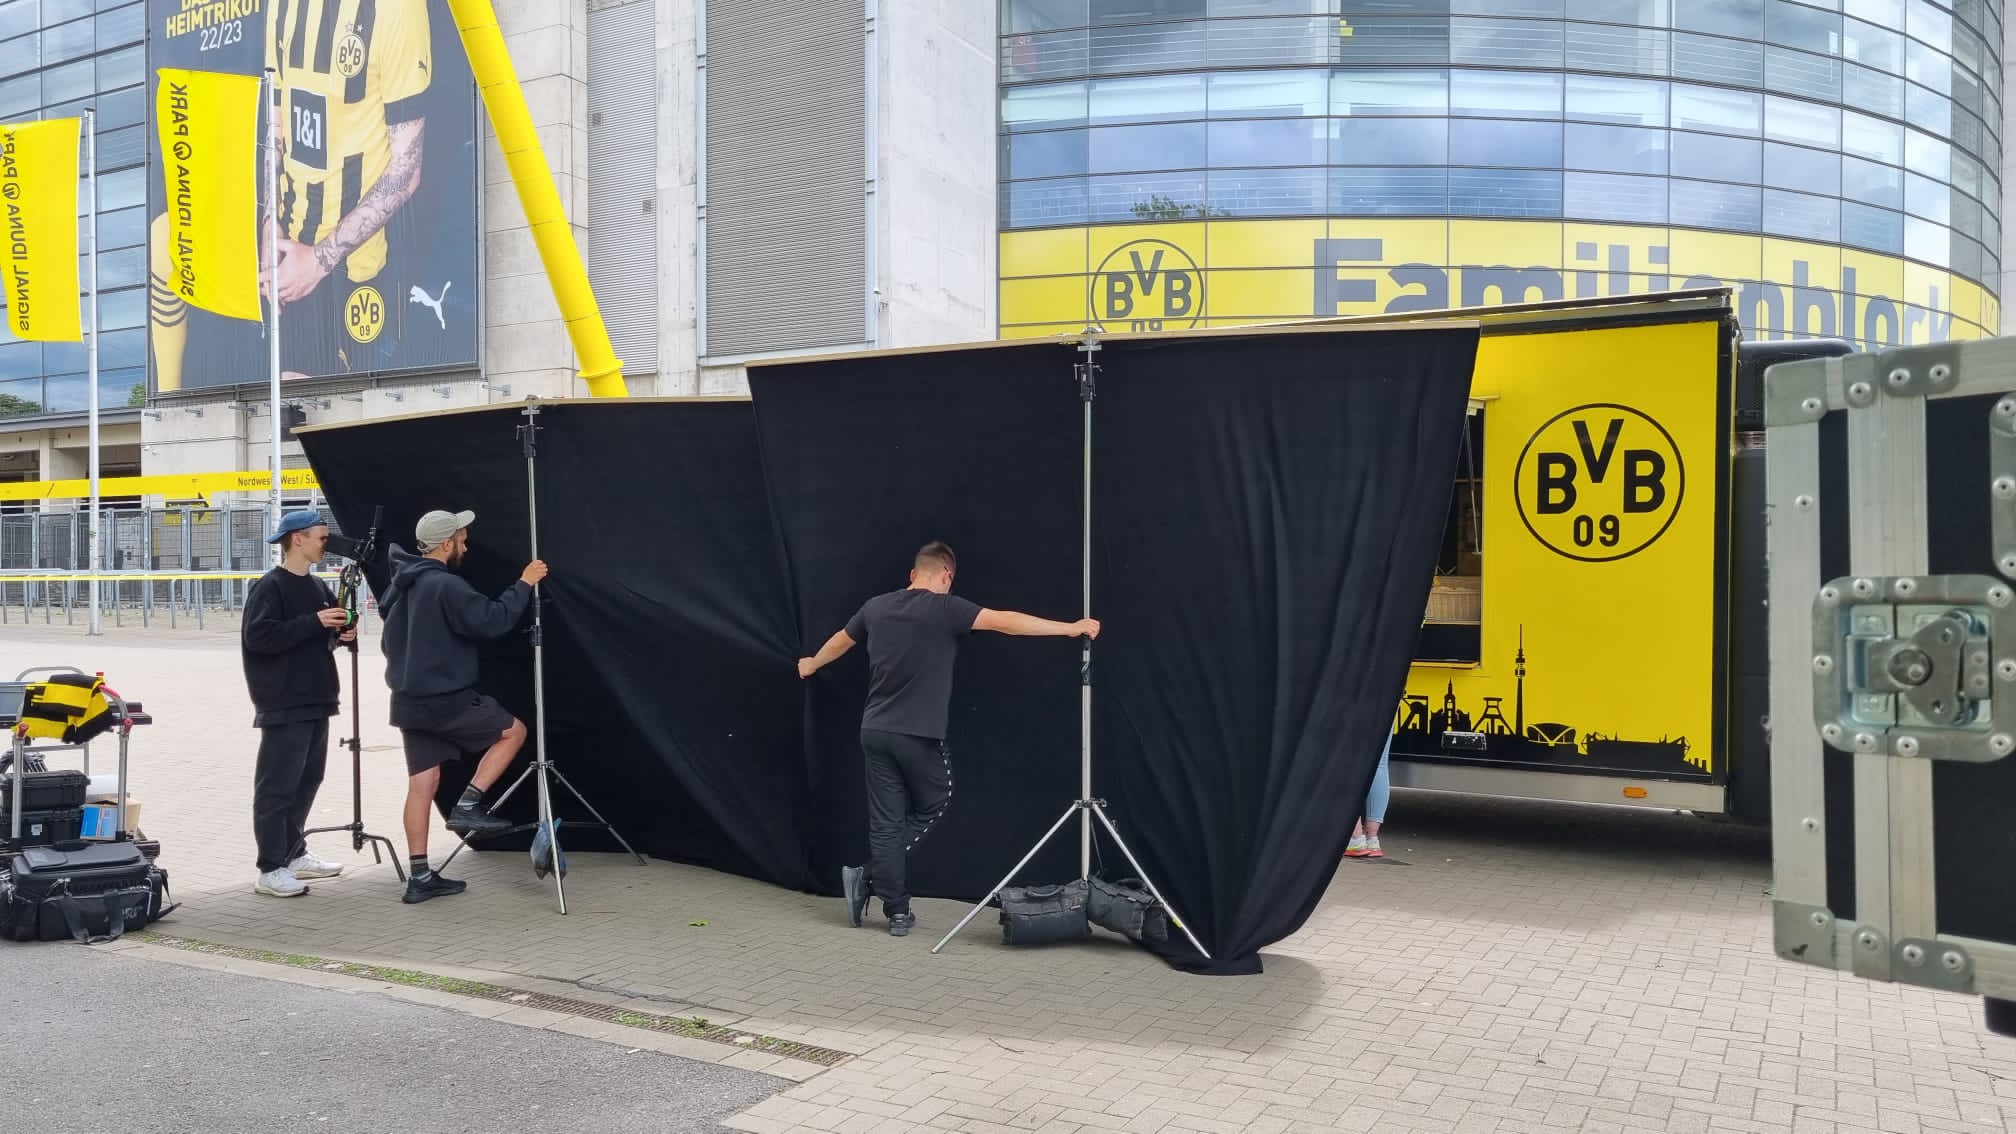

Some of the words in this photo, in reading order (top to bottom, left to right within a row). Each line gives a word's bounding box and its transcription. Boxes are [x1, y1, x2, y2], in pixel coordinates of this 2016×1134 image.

[200, 20, 242, 51] 22/23
[339, 39, 362, 66] BVB
[293, 104, 321, 150] 1&1
[1106, 249, 1192, 319] BVB
[351, 292, 380, 326] BVB
[359, 325, 371, 337] 09
[1536, 418, 1666, 515] BVB
[1573, 514, 1620, 547] 09
